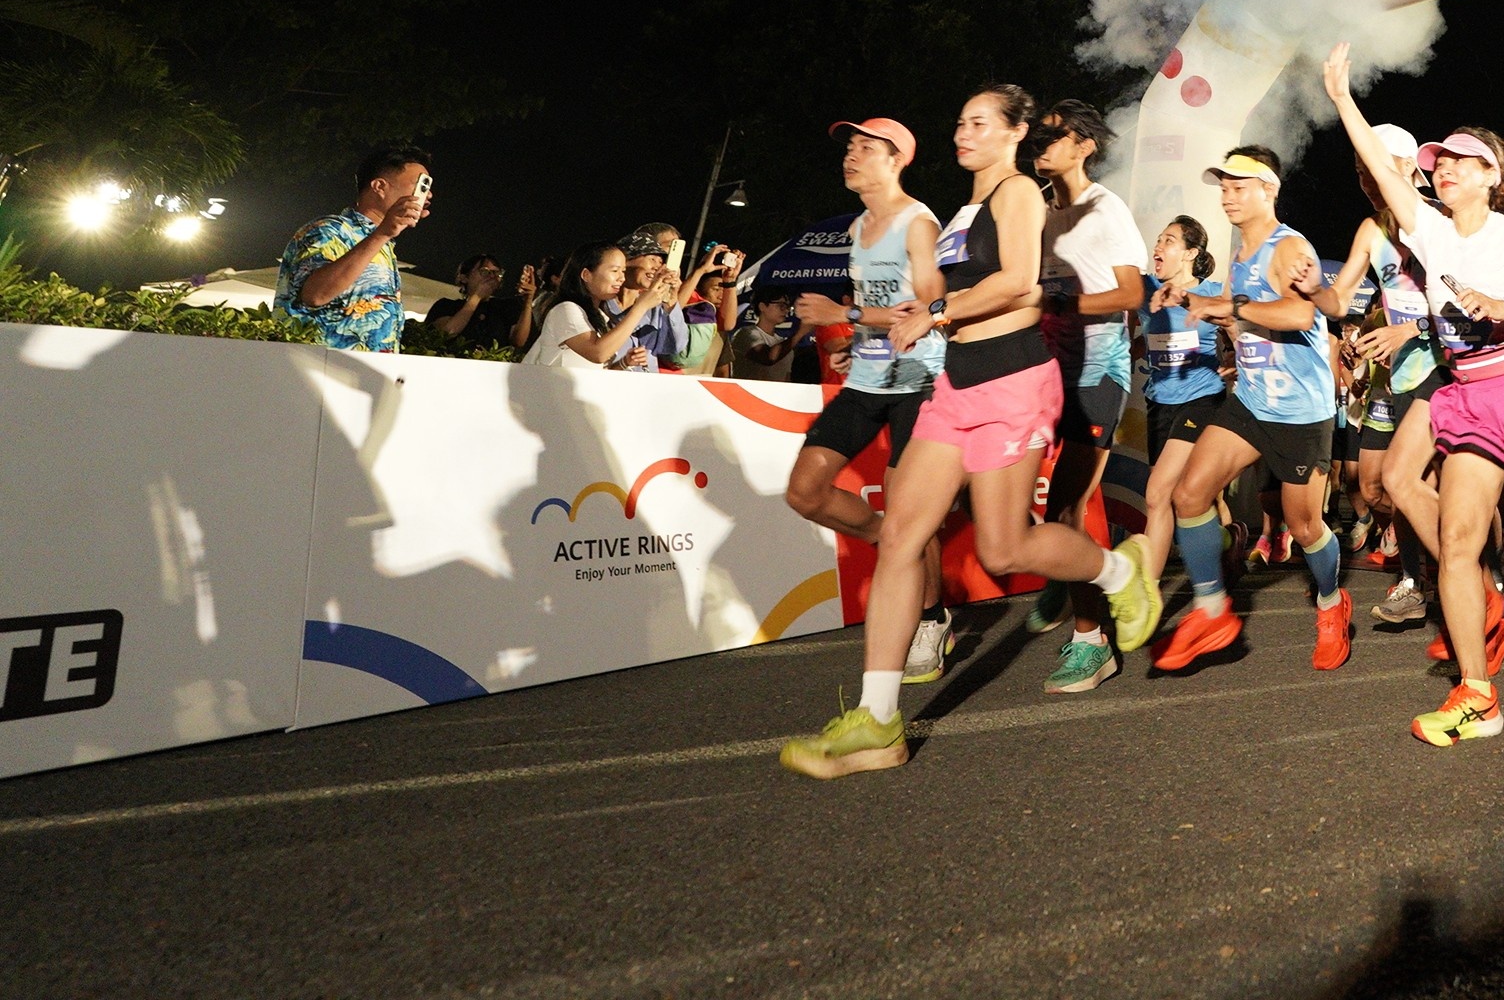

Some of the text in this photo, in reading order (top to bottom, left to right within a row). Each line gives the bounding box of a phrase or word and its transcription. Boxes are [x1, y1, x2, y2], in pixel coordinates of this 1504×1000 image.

[801, 231, 851, 240] POCA
[771, 269, 814, 279] POCARI
[867, 279, 900, 295] ZERO
[1163, 353, 1186, 362] 1352
[553, 533, 694, 562] ACTIVE RINGS
[575, 561, 677, 582] Enjoy Your Moment
